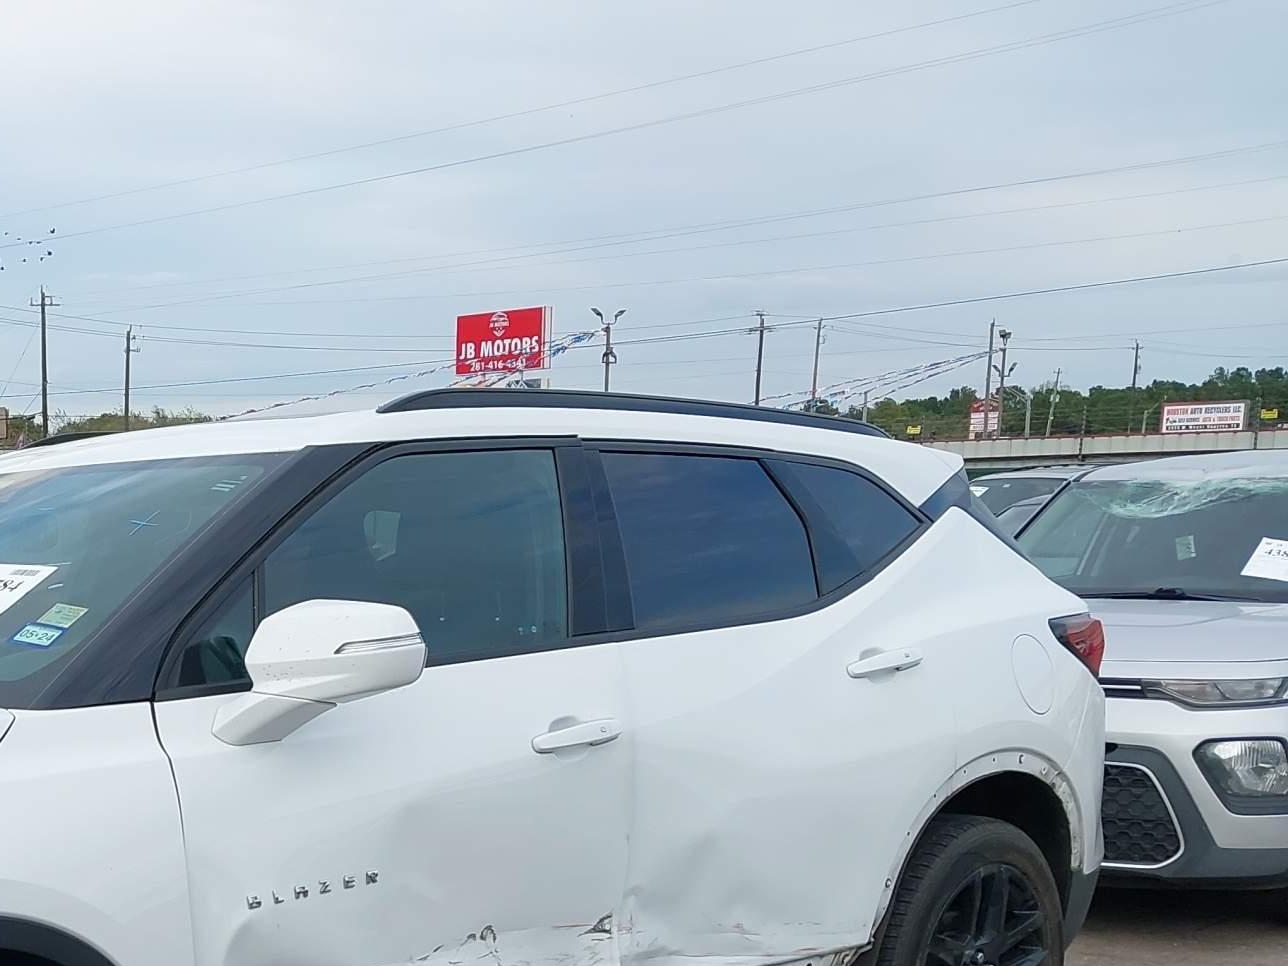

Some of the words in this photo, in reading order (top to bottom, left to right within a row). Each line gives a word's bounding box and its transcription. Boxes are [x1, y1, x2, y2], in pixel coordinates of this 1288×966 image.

[459, 343, 475, 360] JB
[480, 336, 539, 358] MOTORS
[246, 870, 379, 910] BLAZER
